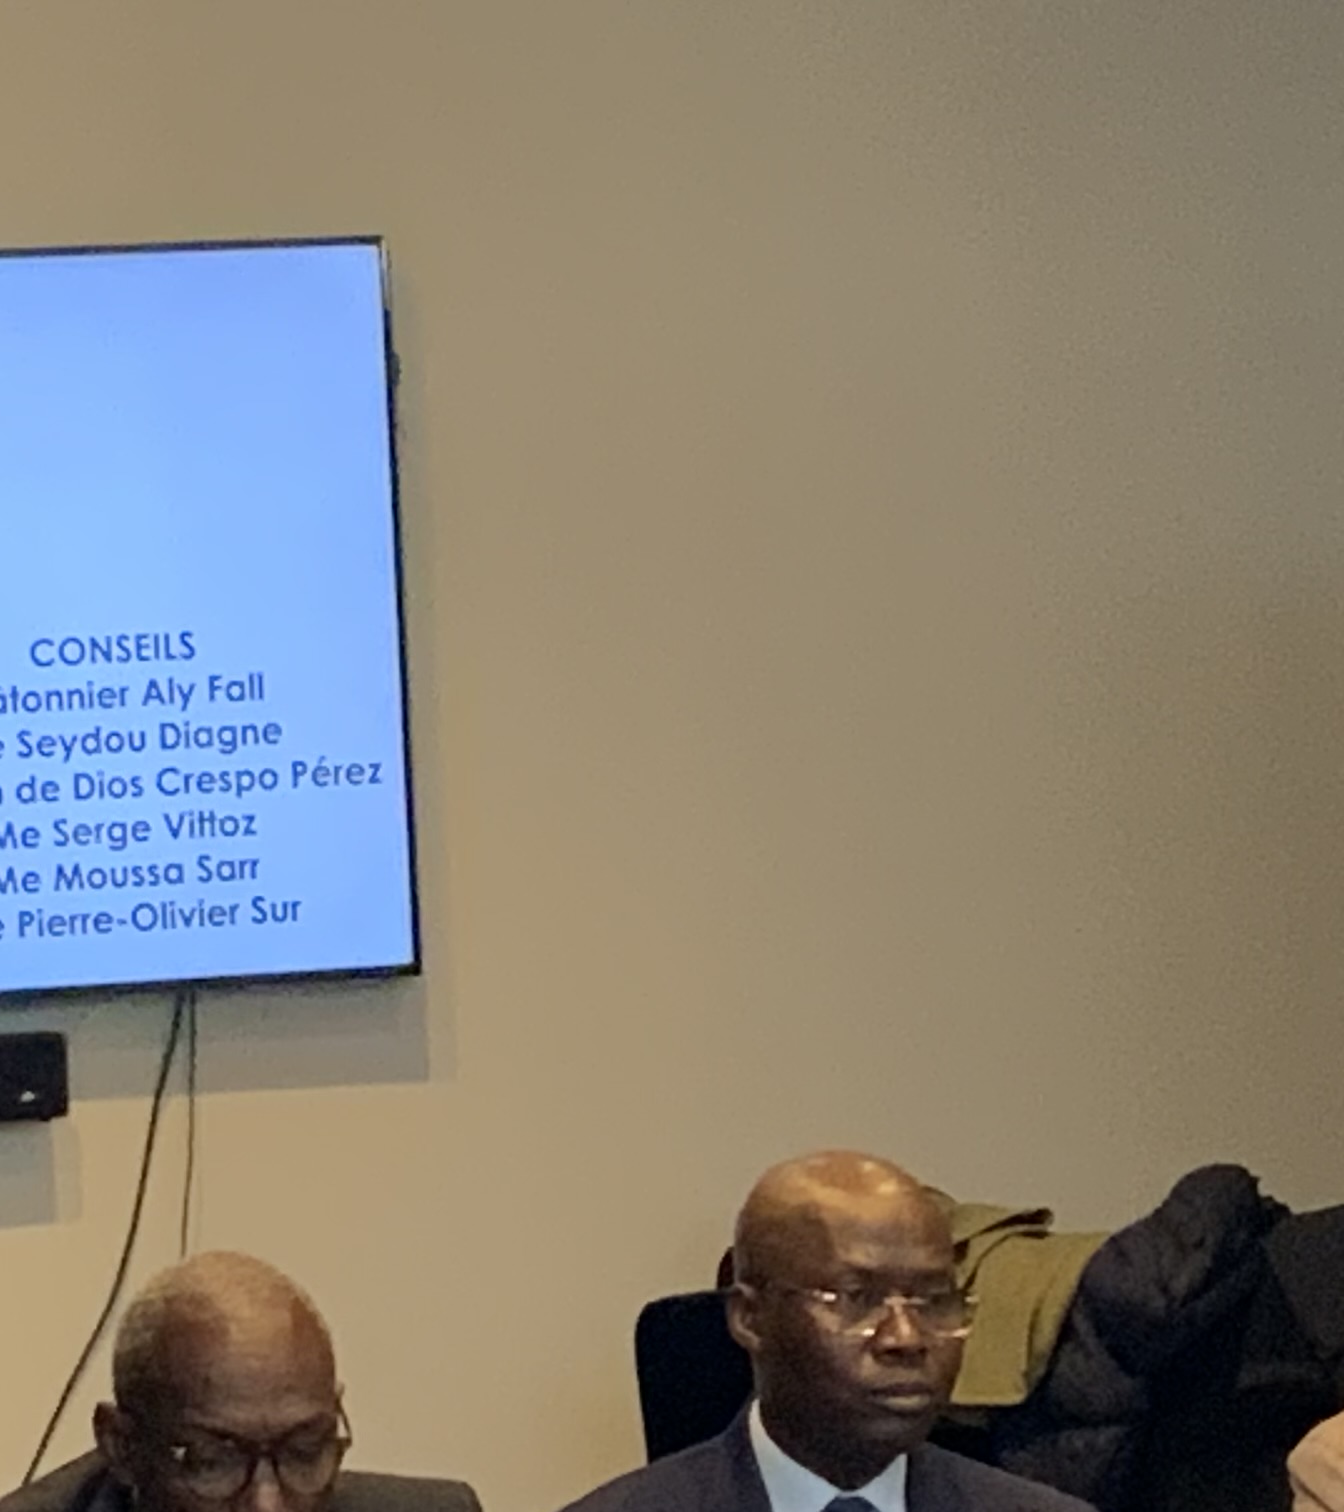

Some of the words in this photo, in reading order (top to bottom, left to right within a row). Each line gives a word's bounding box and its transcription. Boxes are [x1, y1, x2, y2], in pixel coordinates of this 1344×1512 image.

[30, 631, 195, 667] CONSEILS
[142, 677, 195, 712] Aly
[209, 673, 264, 702] Fall
[16, 726, 146, 763] Seydou
[159, 721, 282, 754] Diagne
[16, 775, 60, 804] de
[74, 771, 144, 800] Dios
[156, 767, 278, 798] Crespo
[291, 756, 381, 788] Pérez
[53, 818, 151, 851] Serge
[163, 811, 257, 840] Vittoz
[54, 863, 184, 891] Moussa
[197, 855, 259, 883] Sarr
[18, 899, 239, 938] Pierre-Olivier
[251, 896, 301, 924] Sur
